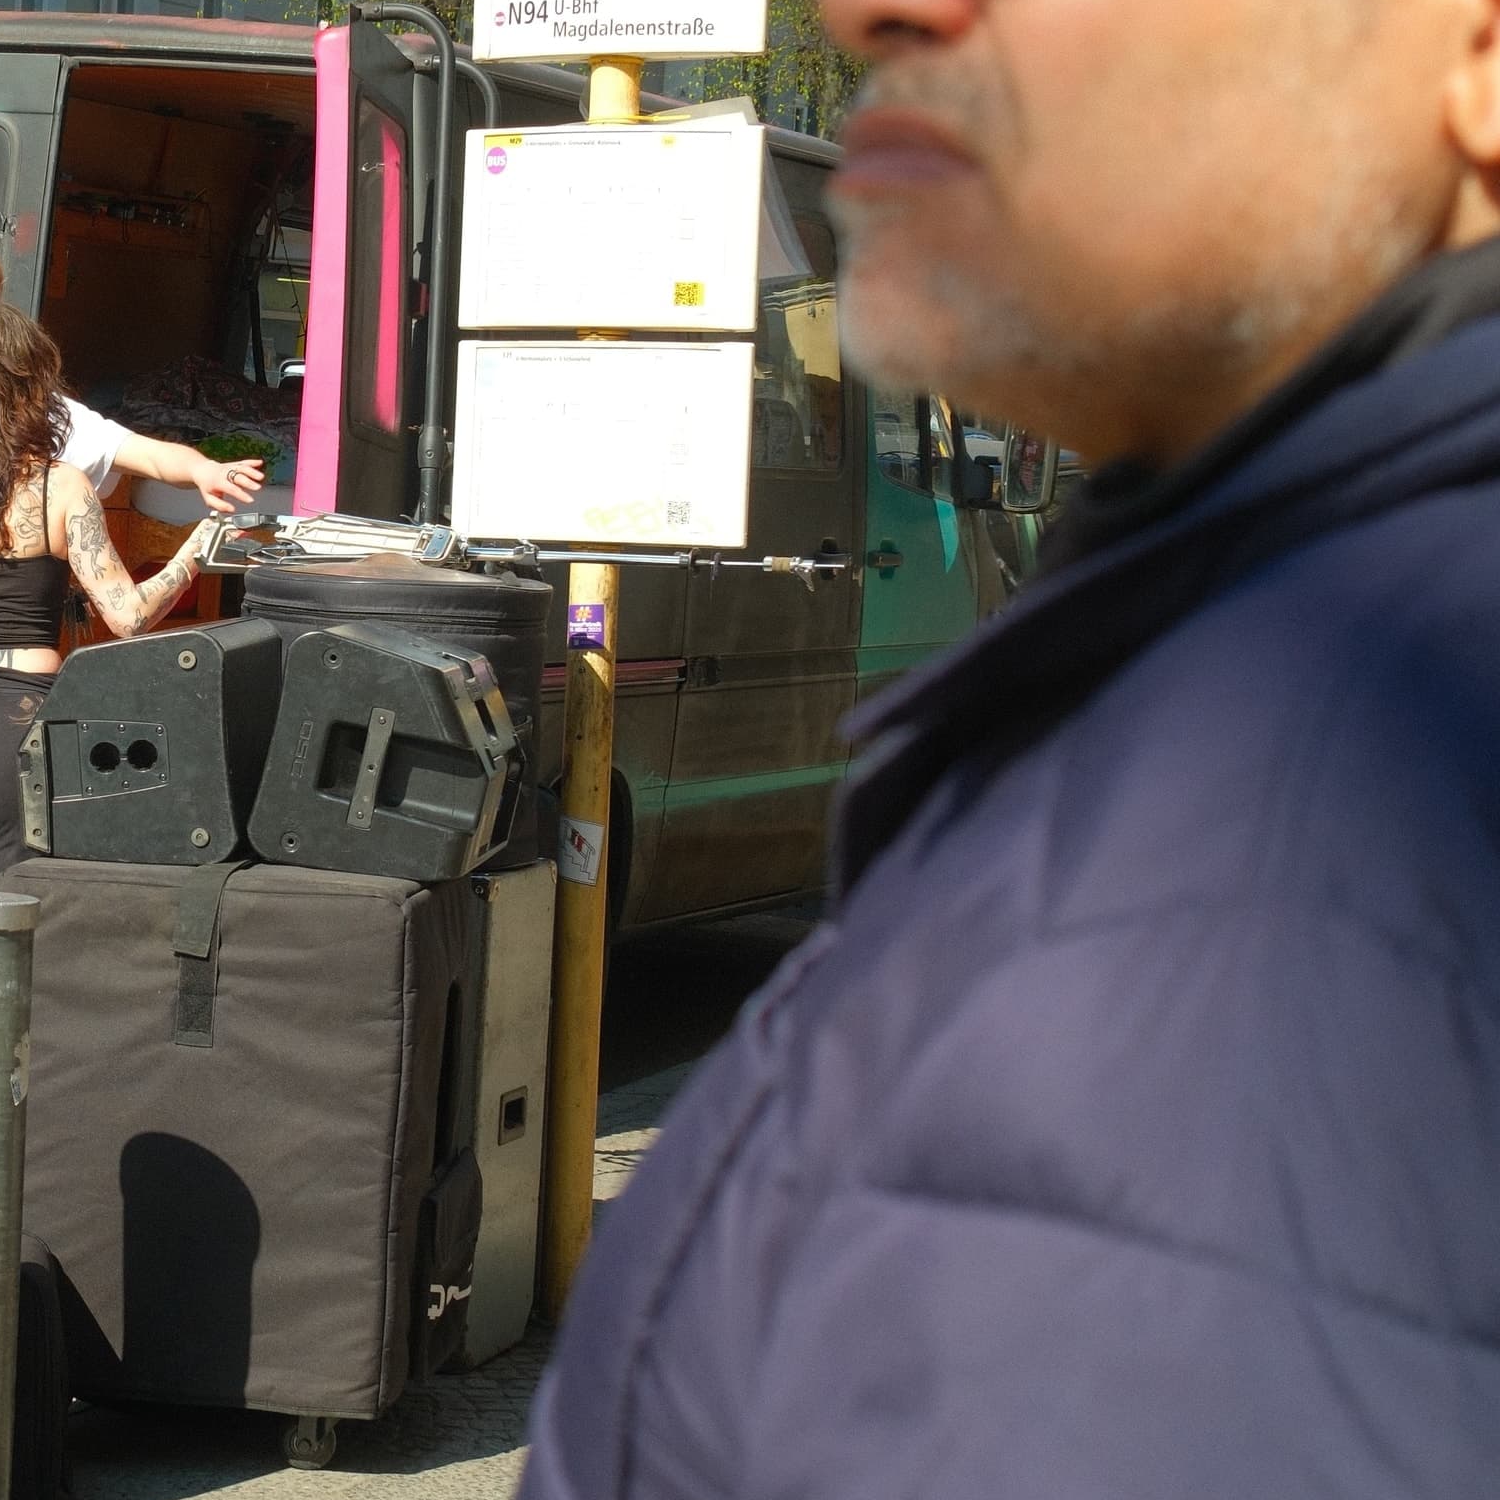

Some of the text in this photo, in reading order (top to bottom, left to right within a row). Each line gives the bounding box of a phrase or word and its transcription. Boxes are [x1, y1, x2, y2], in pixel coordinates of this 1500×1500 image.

[508, 0, 549, 26] N94
[553, 17, 715, 41] Magdalenenstraße
[487, 155, 506, 167] BUS
